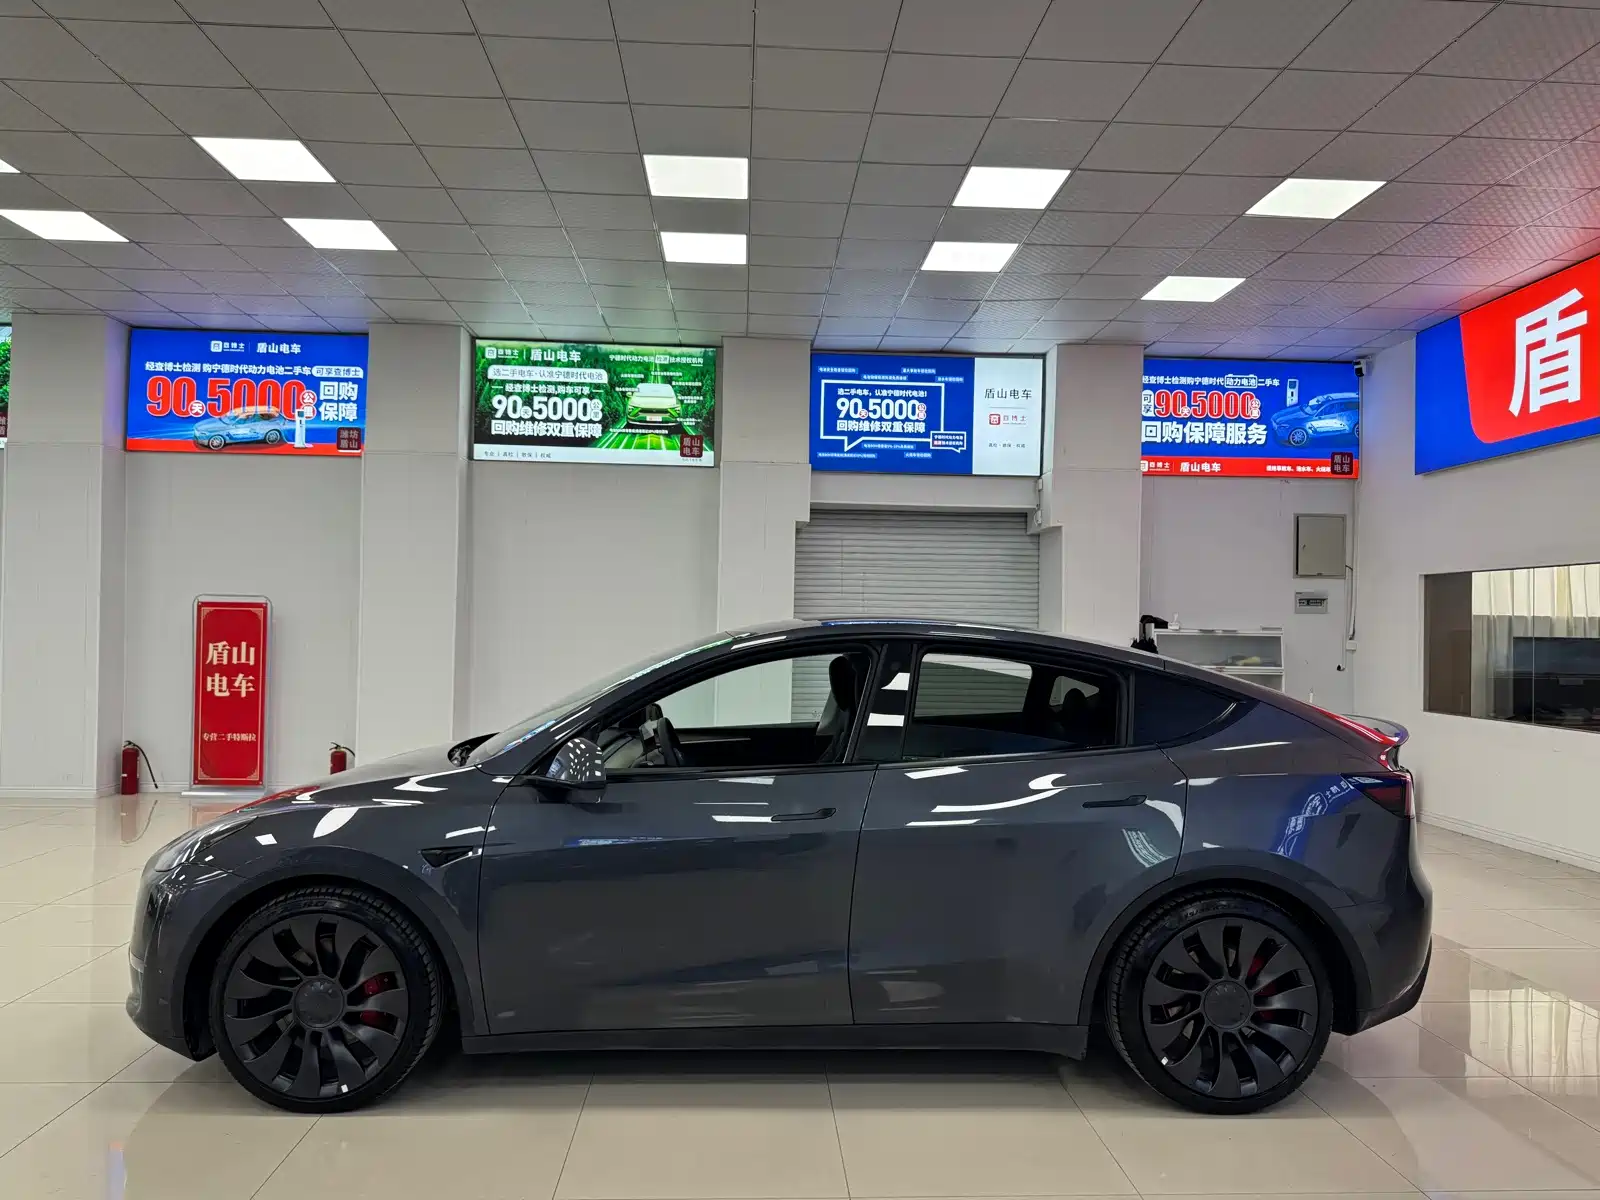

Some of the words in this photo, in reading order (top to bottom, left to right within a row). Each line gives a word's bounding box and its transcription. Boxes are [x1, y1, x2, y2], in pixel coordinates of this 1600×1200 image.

[257, 342, 301, 354] 盾山电车
[1508, 288, 1588, 417] 盾
[530, 349, 582, 362] 盾山电车
[145, 361, 201, 373] 经查博士检测
[319, 381, 358, 401] 回购
[985, 388, 1032, 399] 盾山电车
[319, 402, 358, 422] 保障
[491, 420, 602, 438] 回购维修双重保障
[837, 420, 926, 433] 回购维修双重保障
[1142, 421, 1267, 445] 回购保障服务
[340, 439, 358, 449] 盾山
[683, 438, 700, 446] 盾山
[683, 447, 700, 456] 电车
[1333, 455, 1350, 463] 盾山
[1180, 462, 1221, 472] 盾山电车
[1333, 464, 1350, 472] 电车
[206, 641, 255, 666] 盾山
[206, 673, 256, 698] 电车
[202, 732, 256, 742] 专营二手特斯拉
